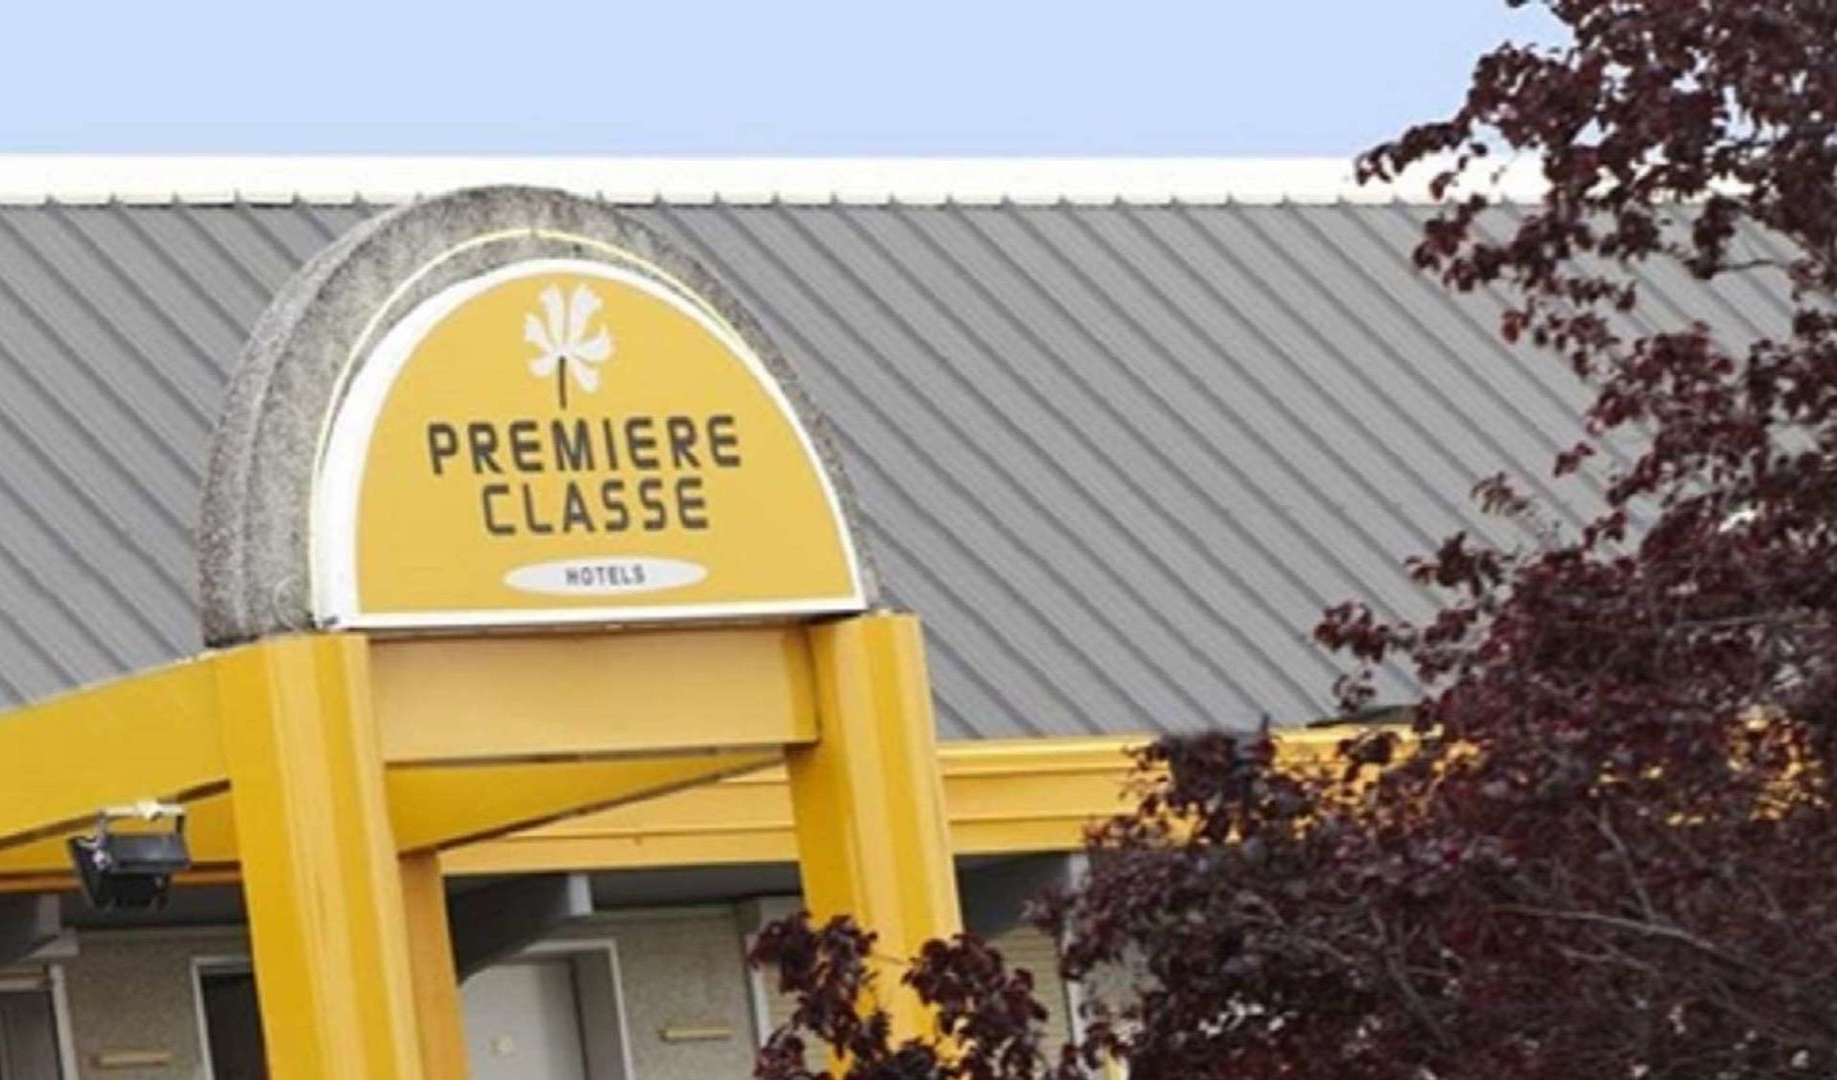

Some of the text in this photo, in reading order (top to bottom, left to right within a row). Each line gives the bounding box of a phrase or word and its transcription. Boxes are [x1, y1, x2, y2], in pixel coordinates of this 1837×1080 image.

[428, 414, 742, 476] PREMIERE
[480, 476, 710, 536] CLASSE
[565, 563, 647, 586] HOTELS
